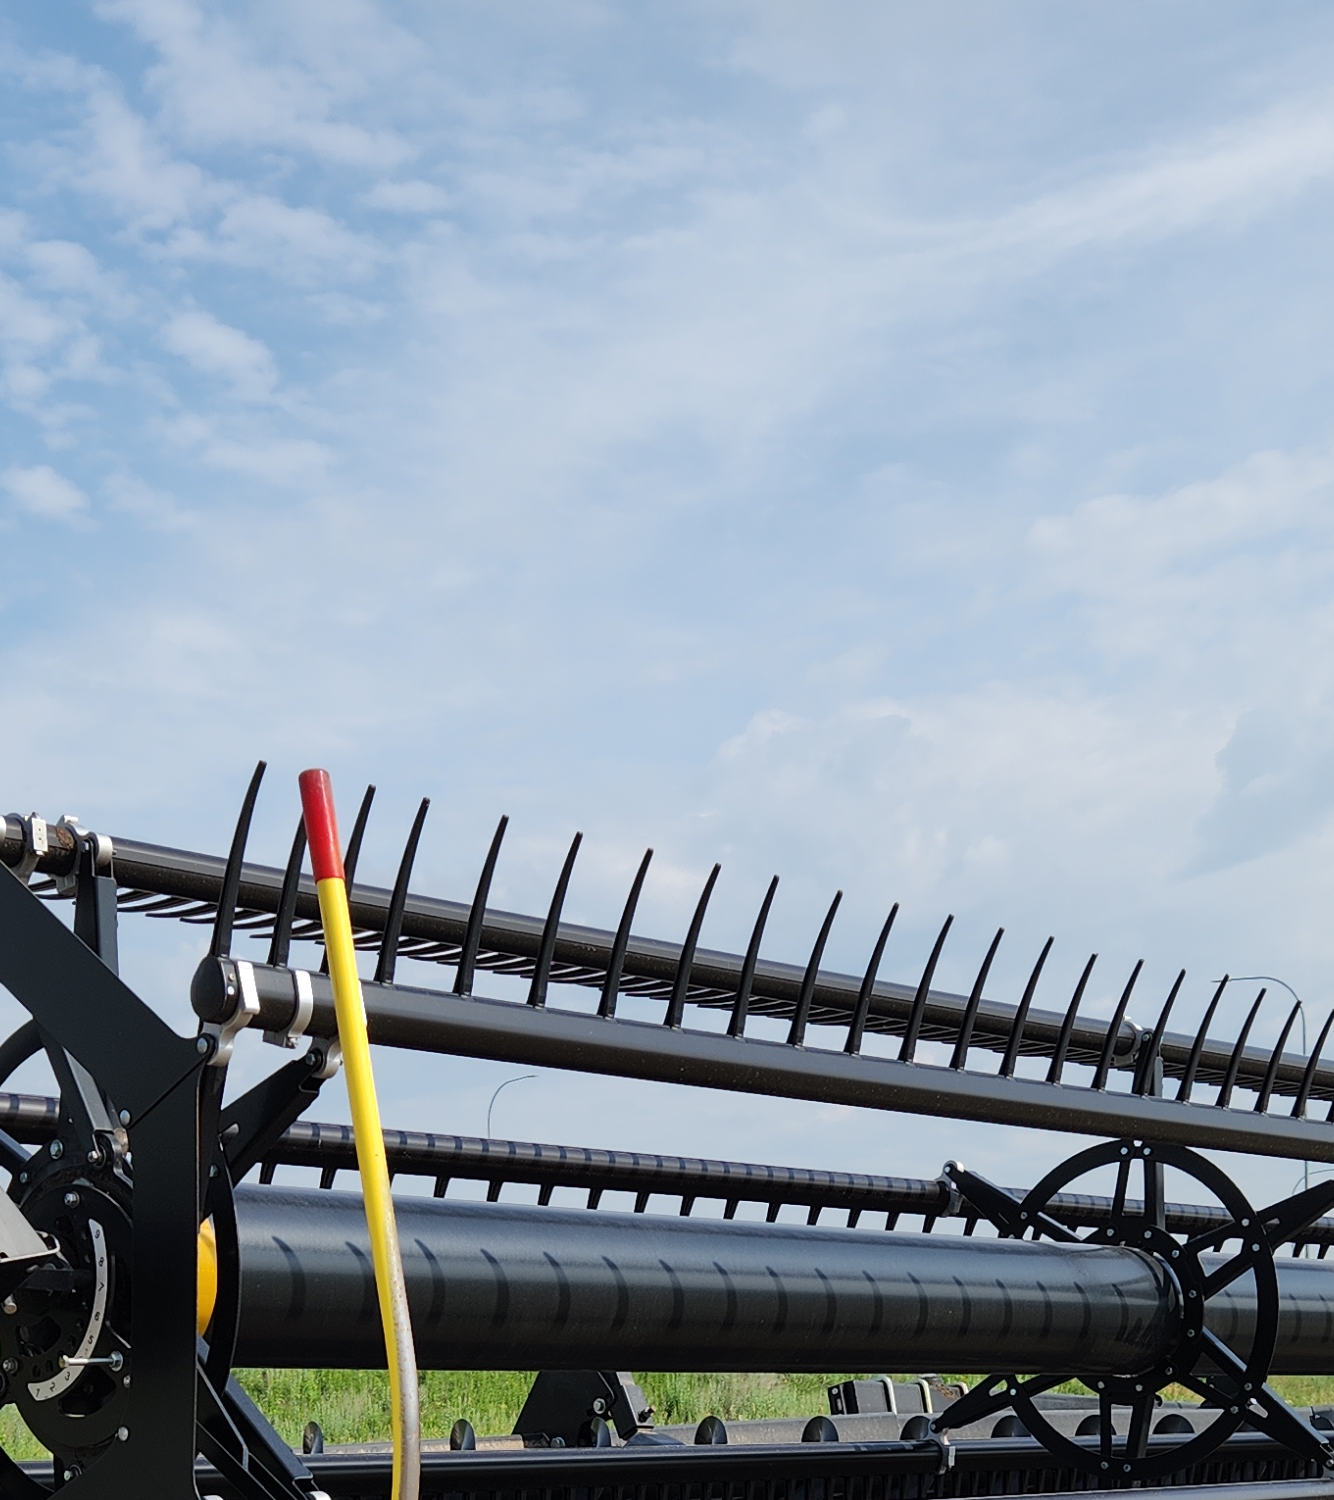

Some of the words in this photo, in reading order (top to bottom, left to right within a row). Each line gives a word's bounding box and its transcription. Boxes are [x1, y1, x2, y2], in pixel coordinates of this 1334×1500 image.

[94, 1229, 101, 1239] 9
[98, 1256, 105, 1267] 8
[98, 1282, 105, 1292] 7
[94, 1311, 101, 1321] 6
[87, 1334, 95, 1345] 5
[64, 1371, 71, 1381] 3
[49, 1381, 57, 1392] 2
